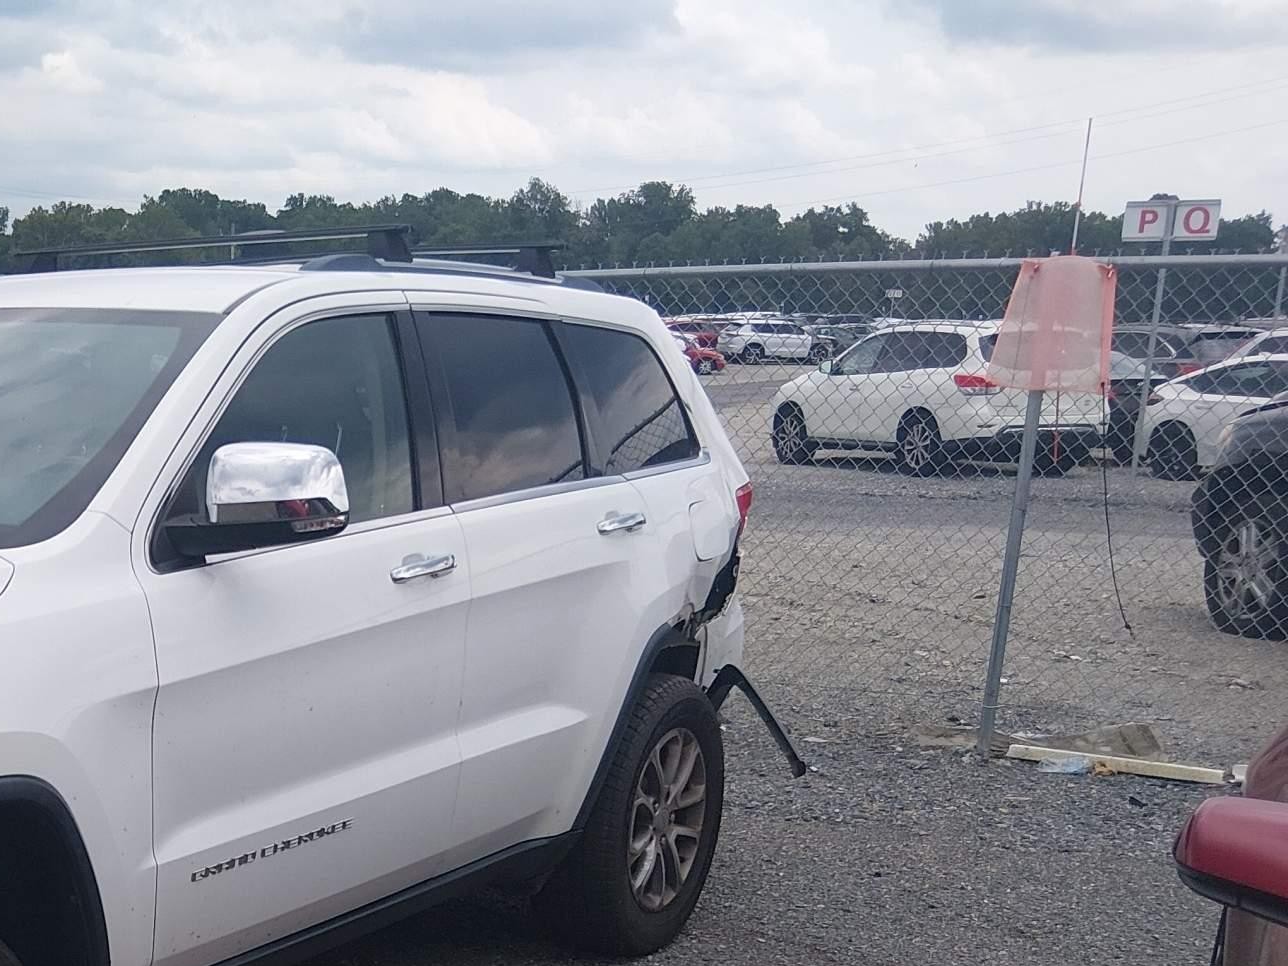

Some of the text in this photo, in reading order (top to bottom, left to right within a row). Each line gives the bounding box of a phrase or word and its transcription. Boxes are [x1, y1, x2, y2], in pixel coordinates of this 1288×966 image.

[1138, 206, 1211, 234] P Q
[190, 816, 354, 882] GRAND CHEROKEE
